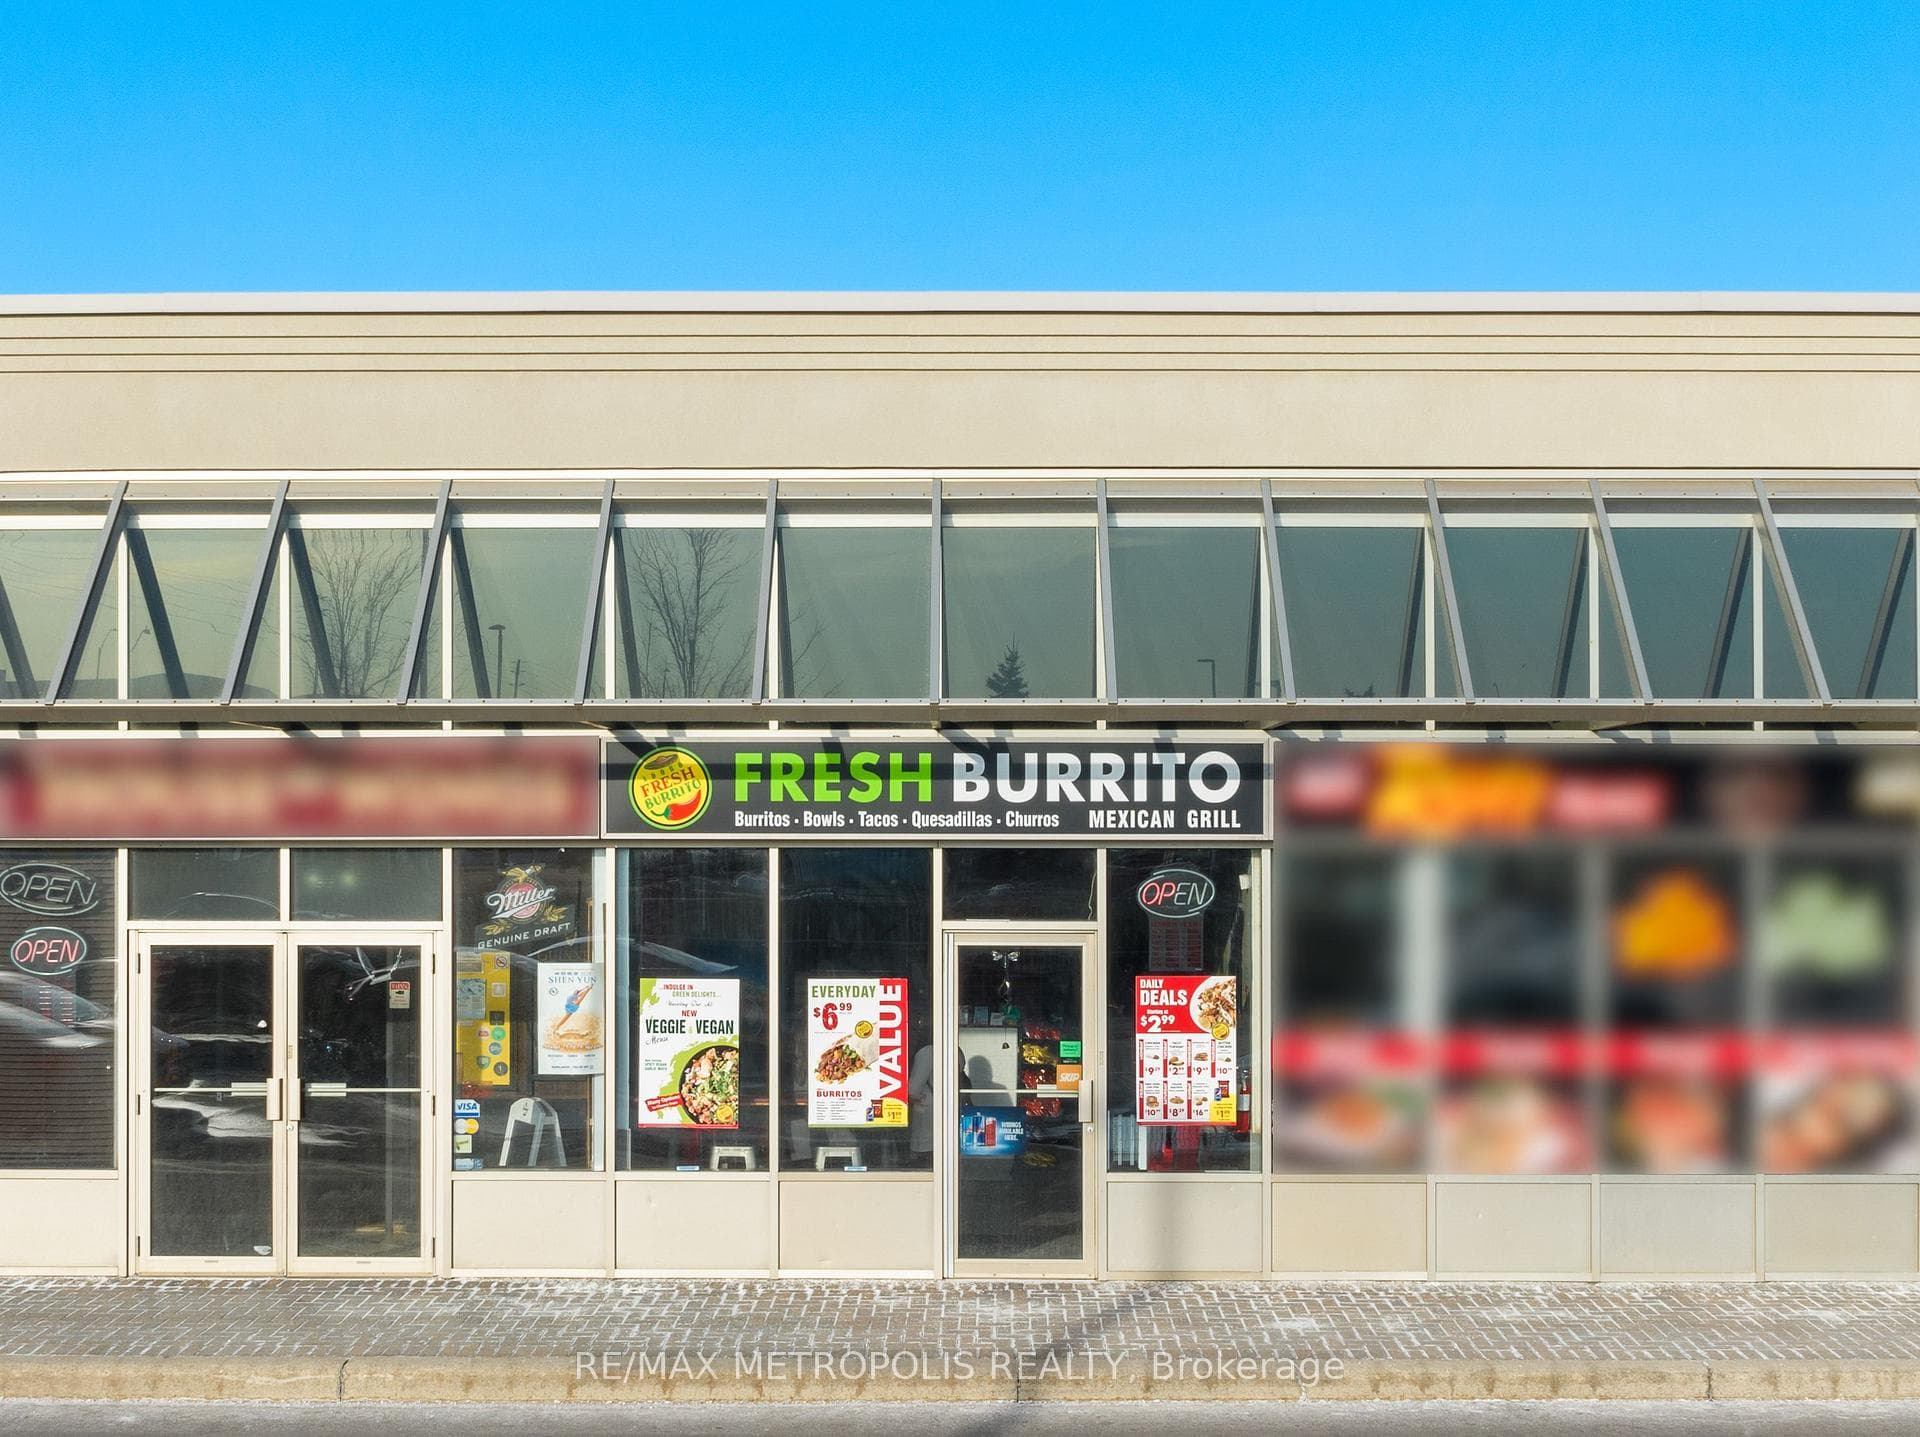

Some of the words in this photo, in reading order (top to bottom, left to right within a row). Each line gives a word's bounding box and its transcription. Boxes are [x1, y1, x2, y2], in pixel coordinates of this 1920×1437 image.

[640, 766, 695, 797] FRESH
[735, 752, 932, 803] FRESH
[953, 751, 1241, 803] BURRITO
[645, 778, 702, 810] BURRITO
[735, 811, 790, 828] Burritos
[803, 811, 845, 828] Bowls
[858, 811, 899, 828] Tacos
[911, 811, 993, 829] Quesadillas
[1005, 811, 1060, 828] Churros
[1088, 810, 1175, 829] MEXICAN
[1187, 810, 1241, 829] GRILL
[1, 871, 97, 905] OPEN
[1142, 882, 1208, 905] OPEN
[487, 886, 555, 919] Miller
[477, 931, 530, 950] GENUINE
[534, 922, 571, 938] DRAFT
[14, 939, 80, 963] OPEN
[548, 975, 574, 984] SHEN
[576, 975, 598, 984] YUN
[1140, 979, 1164, 989] DAILY
[812, 985, 876, 998] EVERYDAY
[1140, 989, 1188, 1006] DEALS
[645, 1019, 686, 1034] VEGGIE
[695, 1019, 734, 1035] VEGAN
[879, 984, 902, 1099] VALUE
[1060, 1072, 1080, 1083] SKIP
[816, 1090, 862, 1098] BURRITOS
[457, 1103, 477, 1111] VISA
